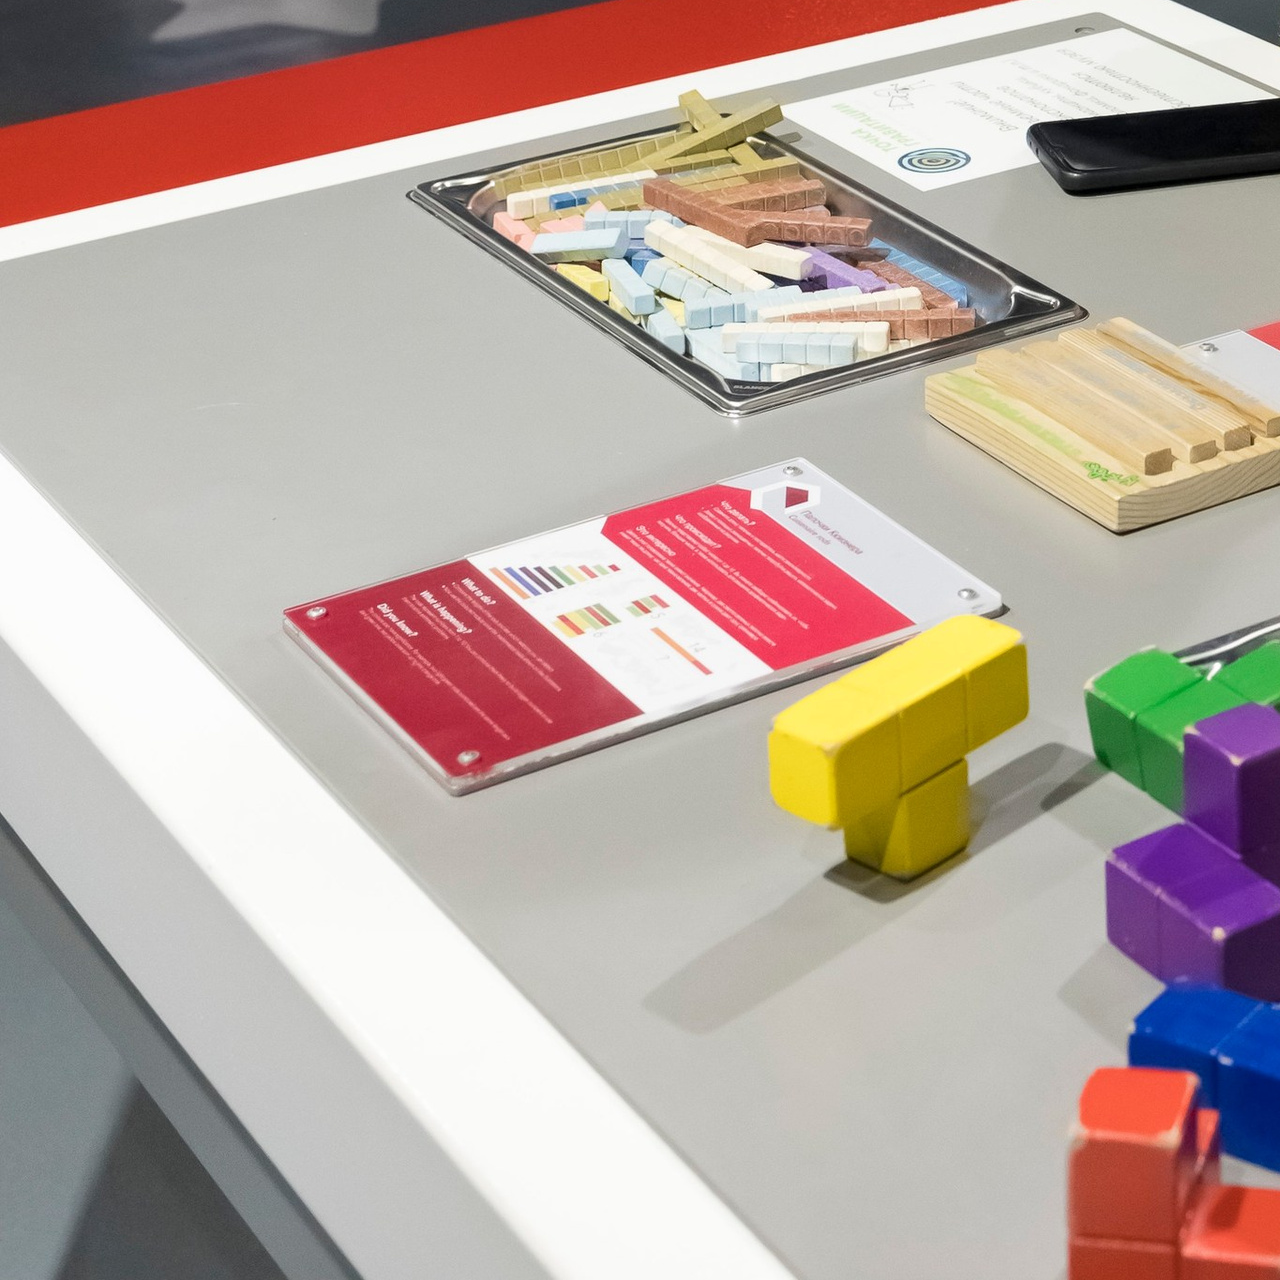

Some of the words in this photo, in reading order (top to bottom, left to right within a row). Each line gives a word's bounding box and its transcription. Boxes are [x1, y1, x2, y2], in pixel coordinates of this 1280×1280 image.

[829, 102, 922, 147] ГРАВИТАЦИИ
[847, 127, 901, 152] ТОЧКА
[458, 577, 481, 591] What
[477, 594, 497, 606] do?
[375, 602, 393, 613] Did
[381, 611, 401, 623] you
[417, 590, 440, 604] What
[433, 606, 474, 635] happening?
[393, 619, 420, 638] know?
